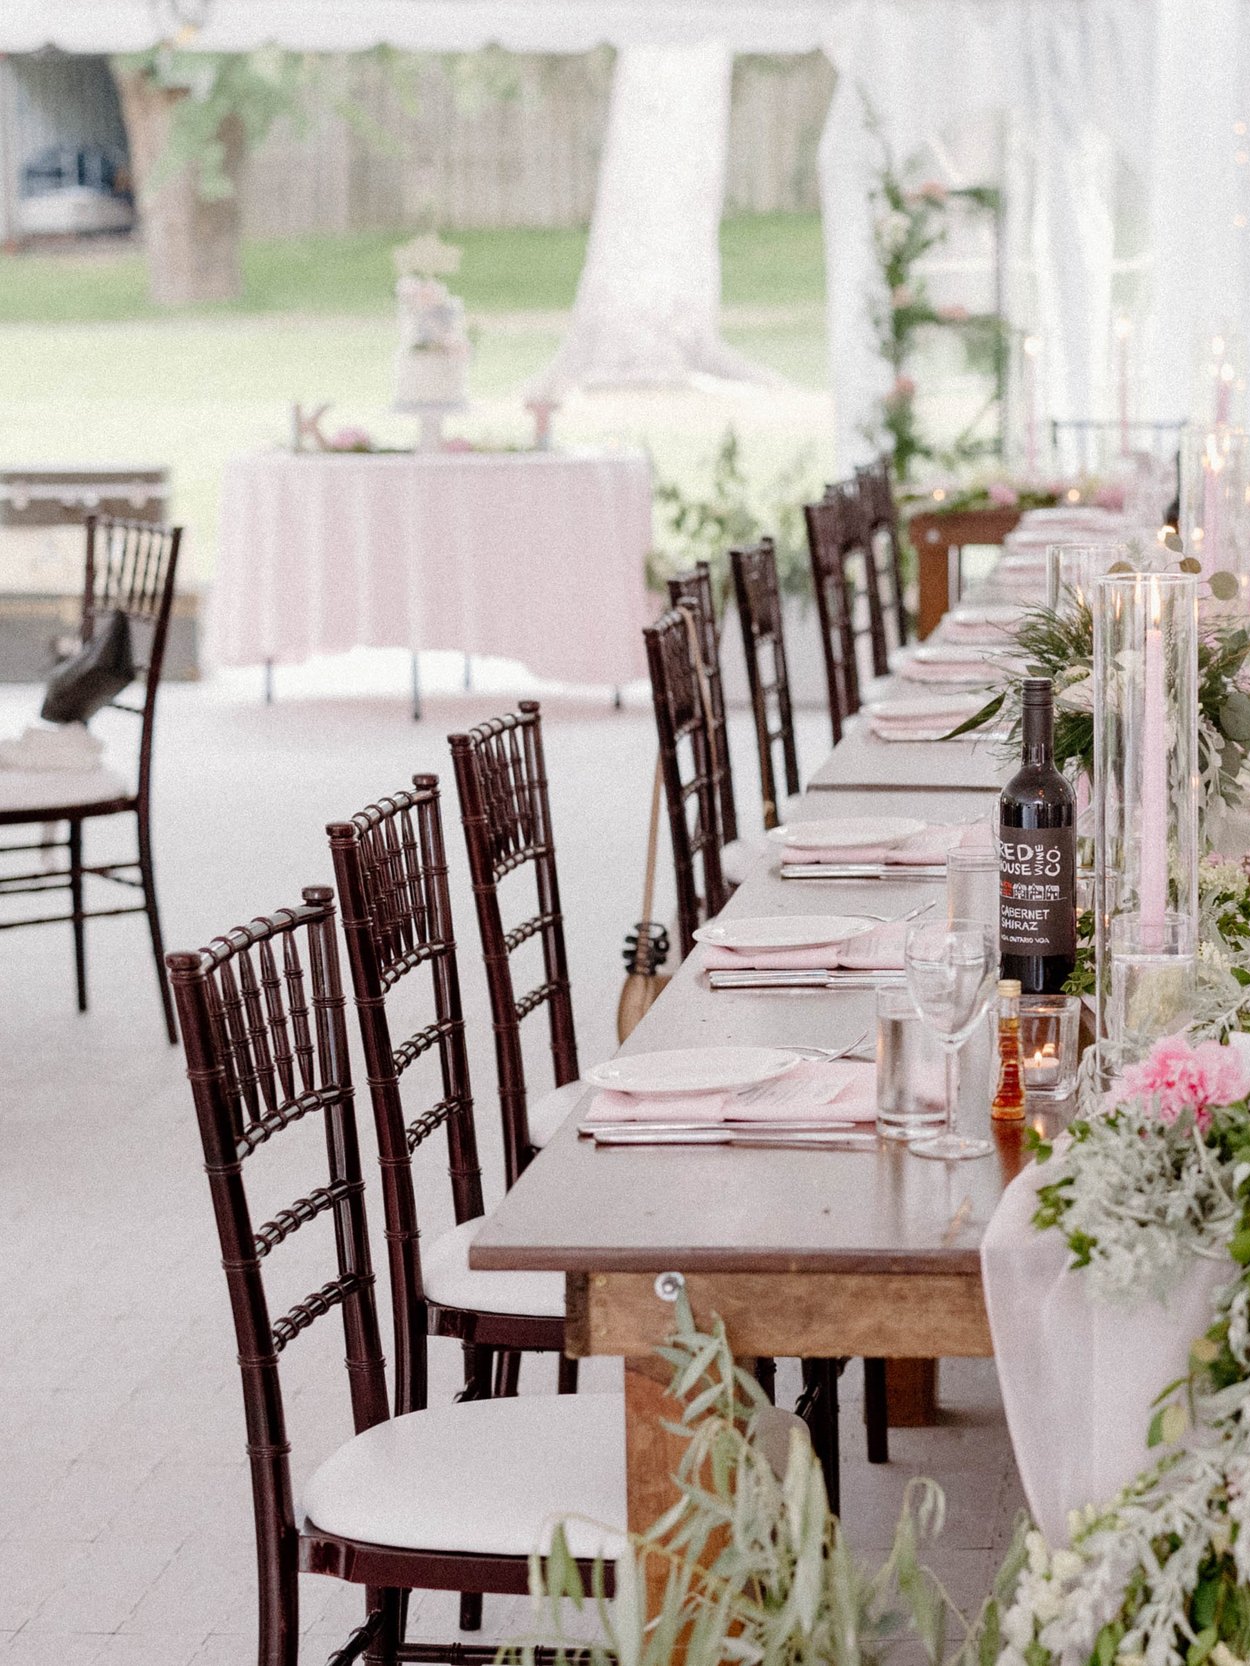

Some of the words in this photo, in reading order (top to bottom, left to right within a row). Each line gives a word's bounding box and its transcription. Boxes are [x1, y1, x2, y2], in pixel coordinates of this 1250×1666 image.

[291, 403, 332, 452] K
[1000, 840, 1034, 861] RED
[1034, 844, 1044, 876] WINE
[1045, 845, 1061, 877] CO.
[1001, 860, 1032, 876] OUSE
[1001, 904, 1050, 920] CABERNET
[1001, 916, 1039, 931] SHIRAZ
